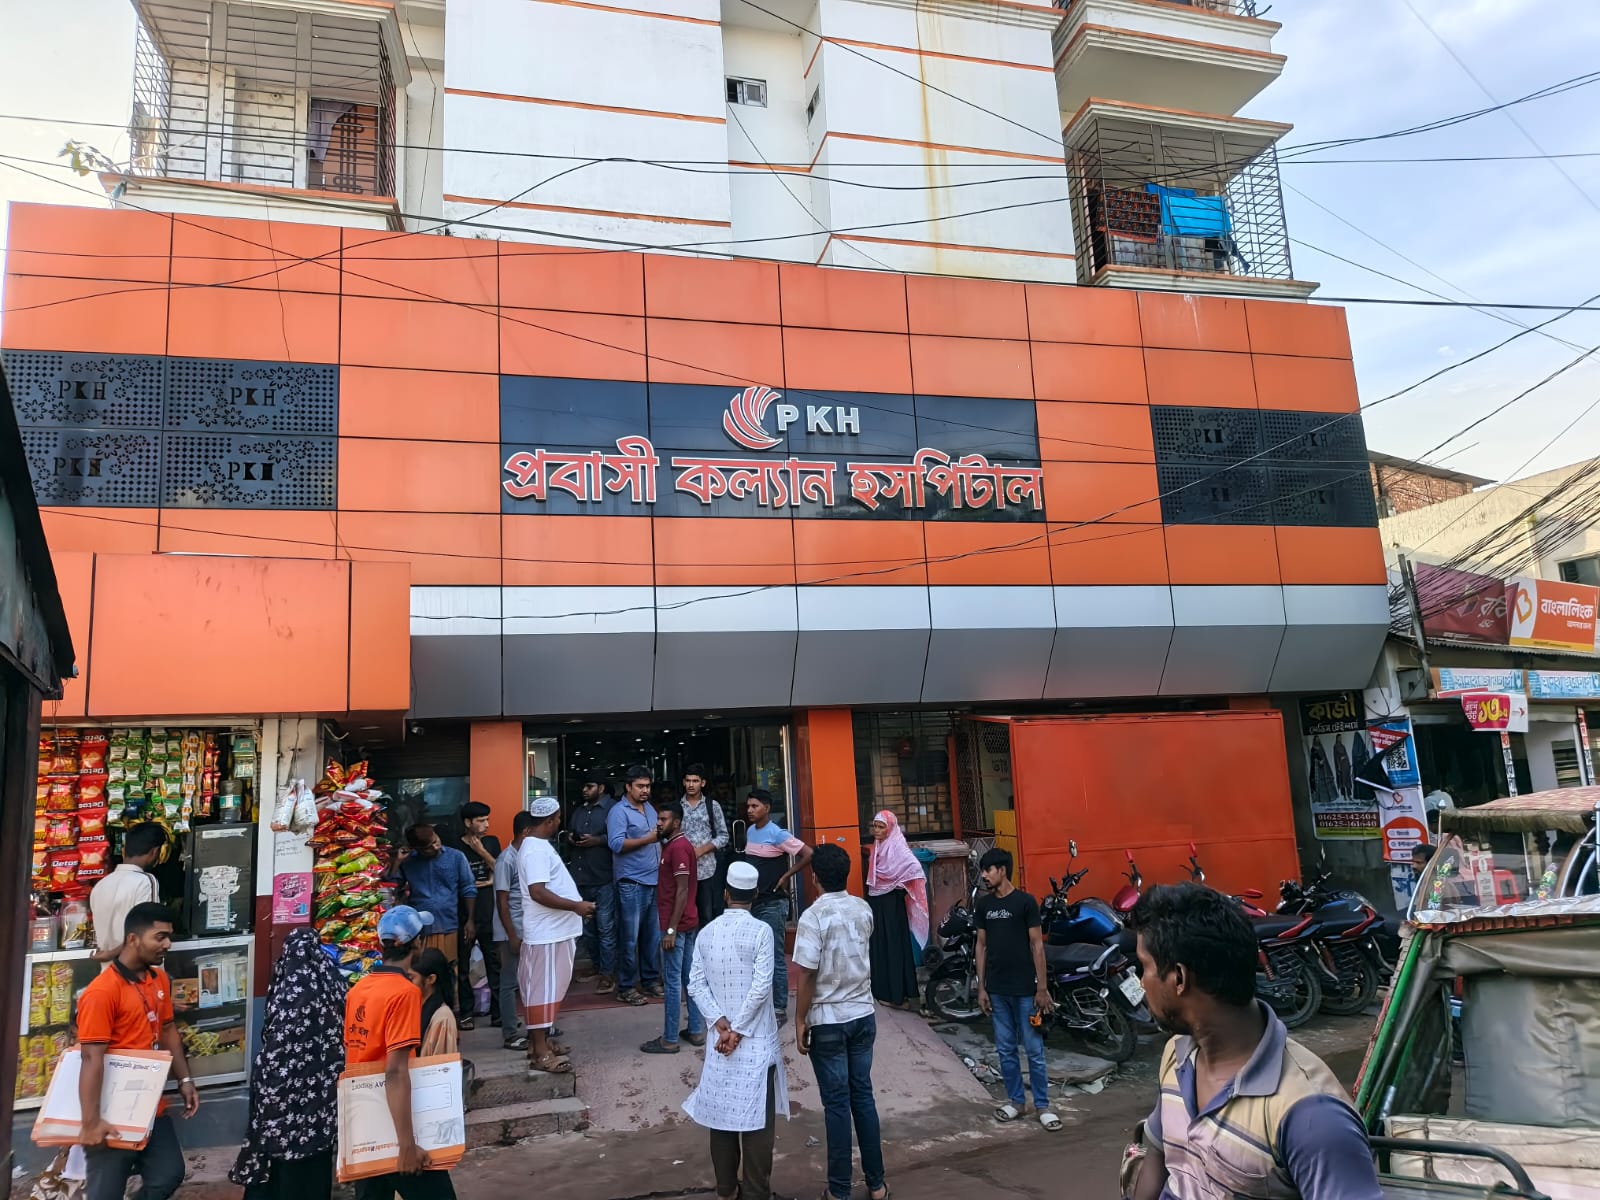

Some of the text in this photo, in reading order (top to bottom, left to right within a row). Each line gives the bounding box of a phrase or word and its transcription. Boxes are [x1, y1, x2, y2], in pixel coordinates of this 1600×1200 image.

[57, 380, 107, 400] PKH
[230, 386, 276, 407] PKH
[776, 404, 860, 434] PKH
[503, 435, 1044, 511] প্রবাসী কল্যান হসপিটাল
[1540, 597, 1594, 619] বাংলালিংক
